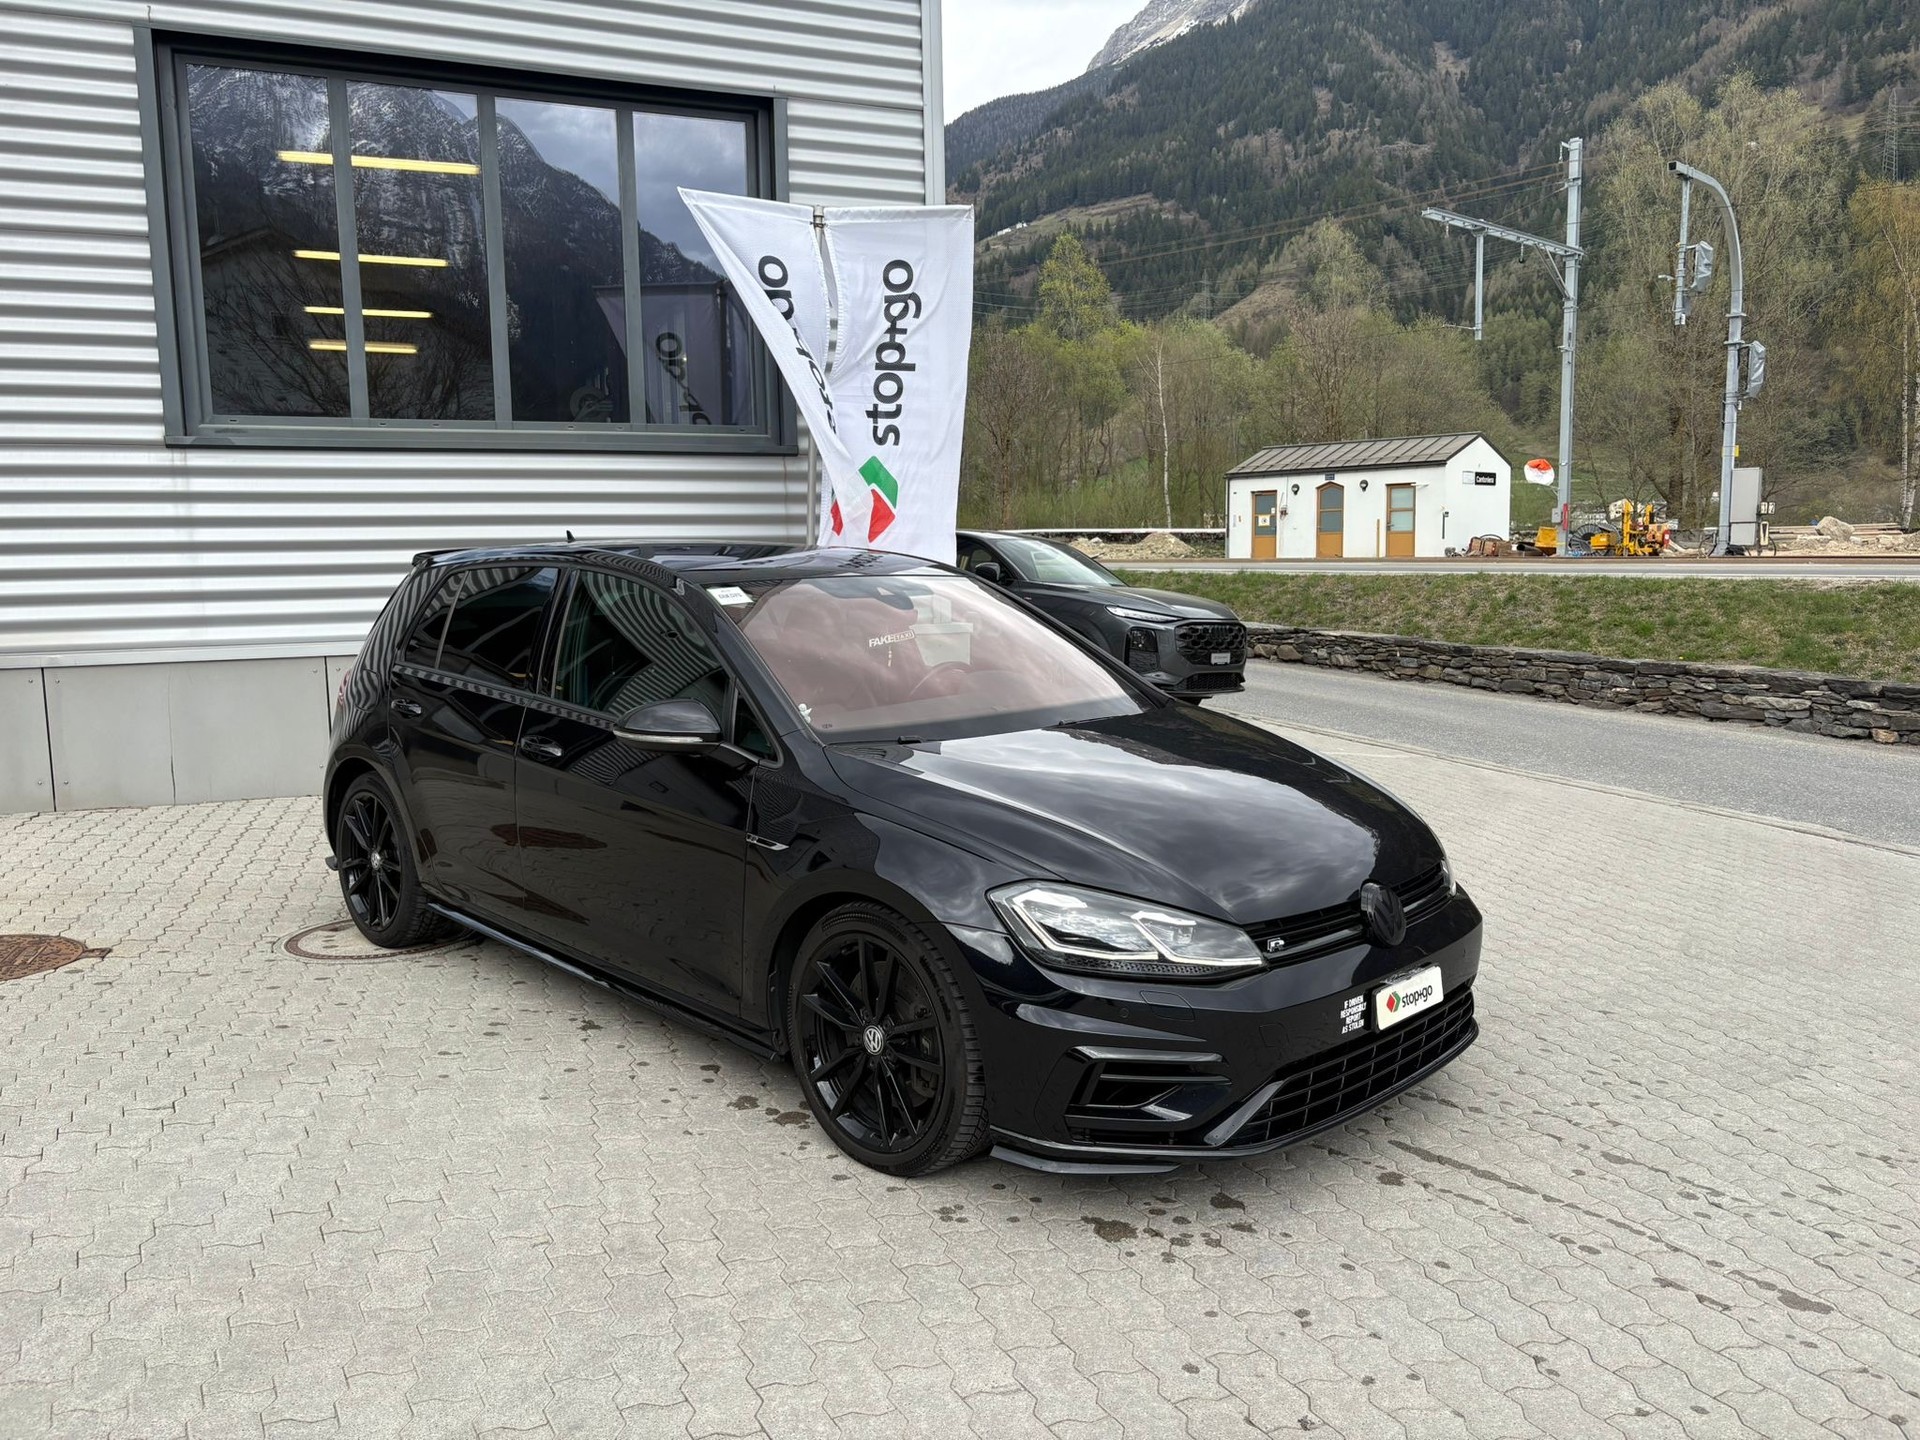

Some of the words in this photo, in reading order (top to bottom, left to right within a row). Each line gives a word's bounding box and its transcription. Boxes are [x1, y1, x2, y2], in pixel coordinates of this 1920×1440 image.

[865, 259, 922, 446] stop+go
[868, 634, 894, 648] FAKE
[1349, 995, 1364, 1007] DRIVEN
[1401, 984, 1433, 1008] stop+go
[1345, 1012, 1362, 1025] REPORT
[1349, 1019, 1365, 1032] STOLEN
